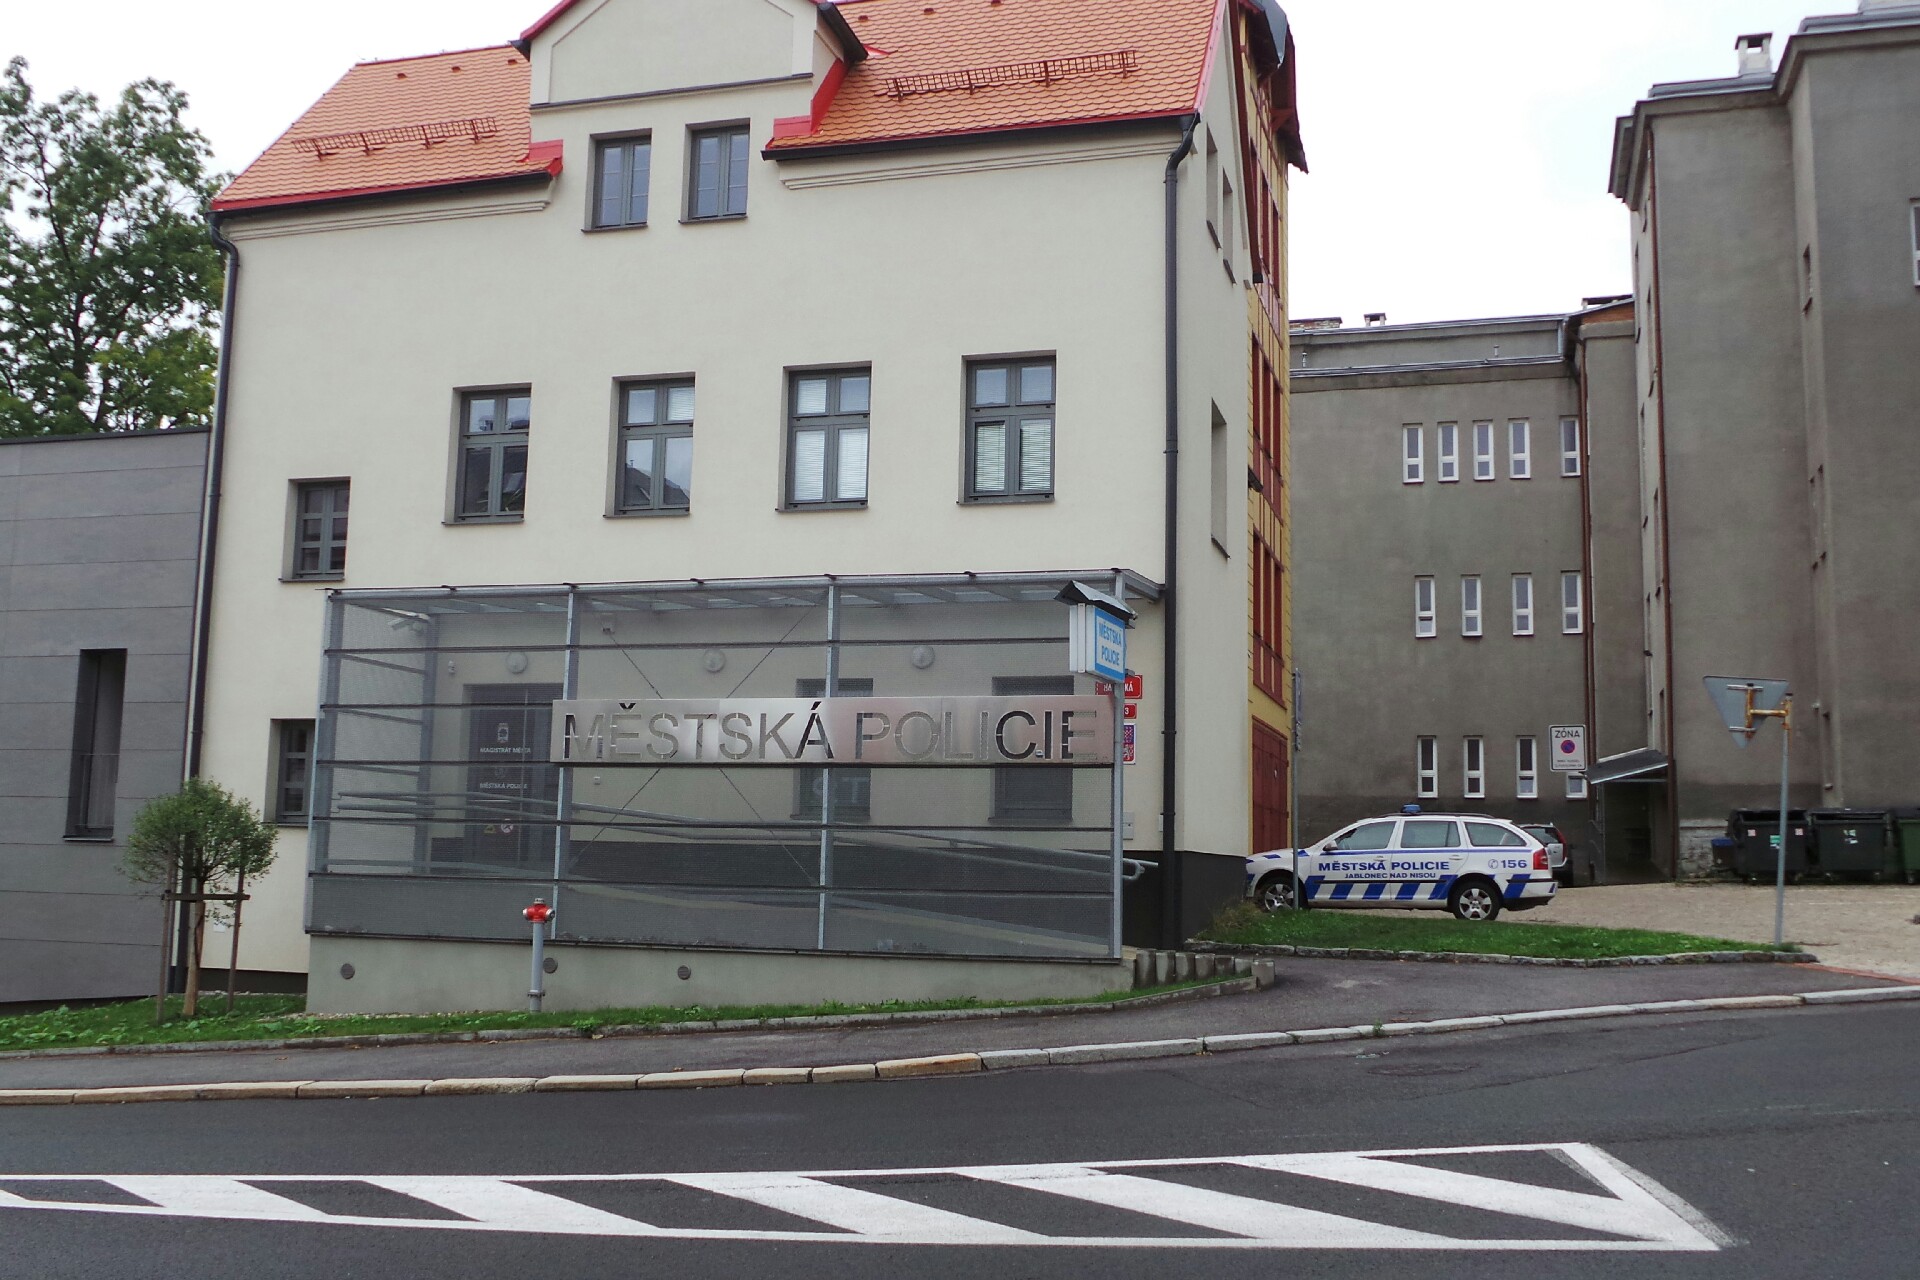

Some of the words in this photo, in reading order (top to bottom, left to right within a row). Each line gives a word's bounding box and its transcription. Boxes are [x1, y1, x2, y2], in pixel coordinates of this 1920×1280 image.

[1099, 621, 1121, 646] MĚSTSKÁ
[1101, 645, 1120, 666] POLICIE
[563, 701, 834, 760] MĚSTSKÁ
[855, 710, 1098, 761] POLICIE
[1554, 727, 1580, 739] ZÓNA
[1318, 860, 1386, 871] MĚSTSKÁ
[1391, 861, 1449, 871] POLICIE
[1500, 859, 1527, 869] 156
